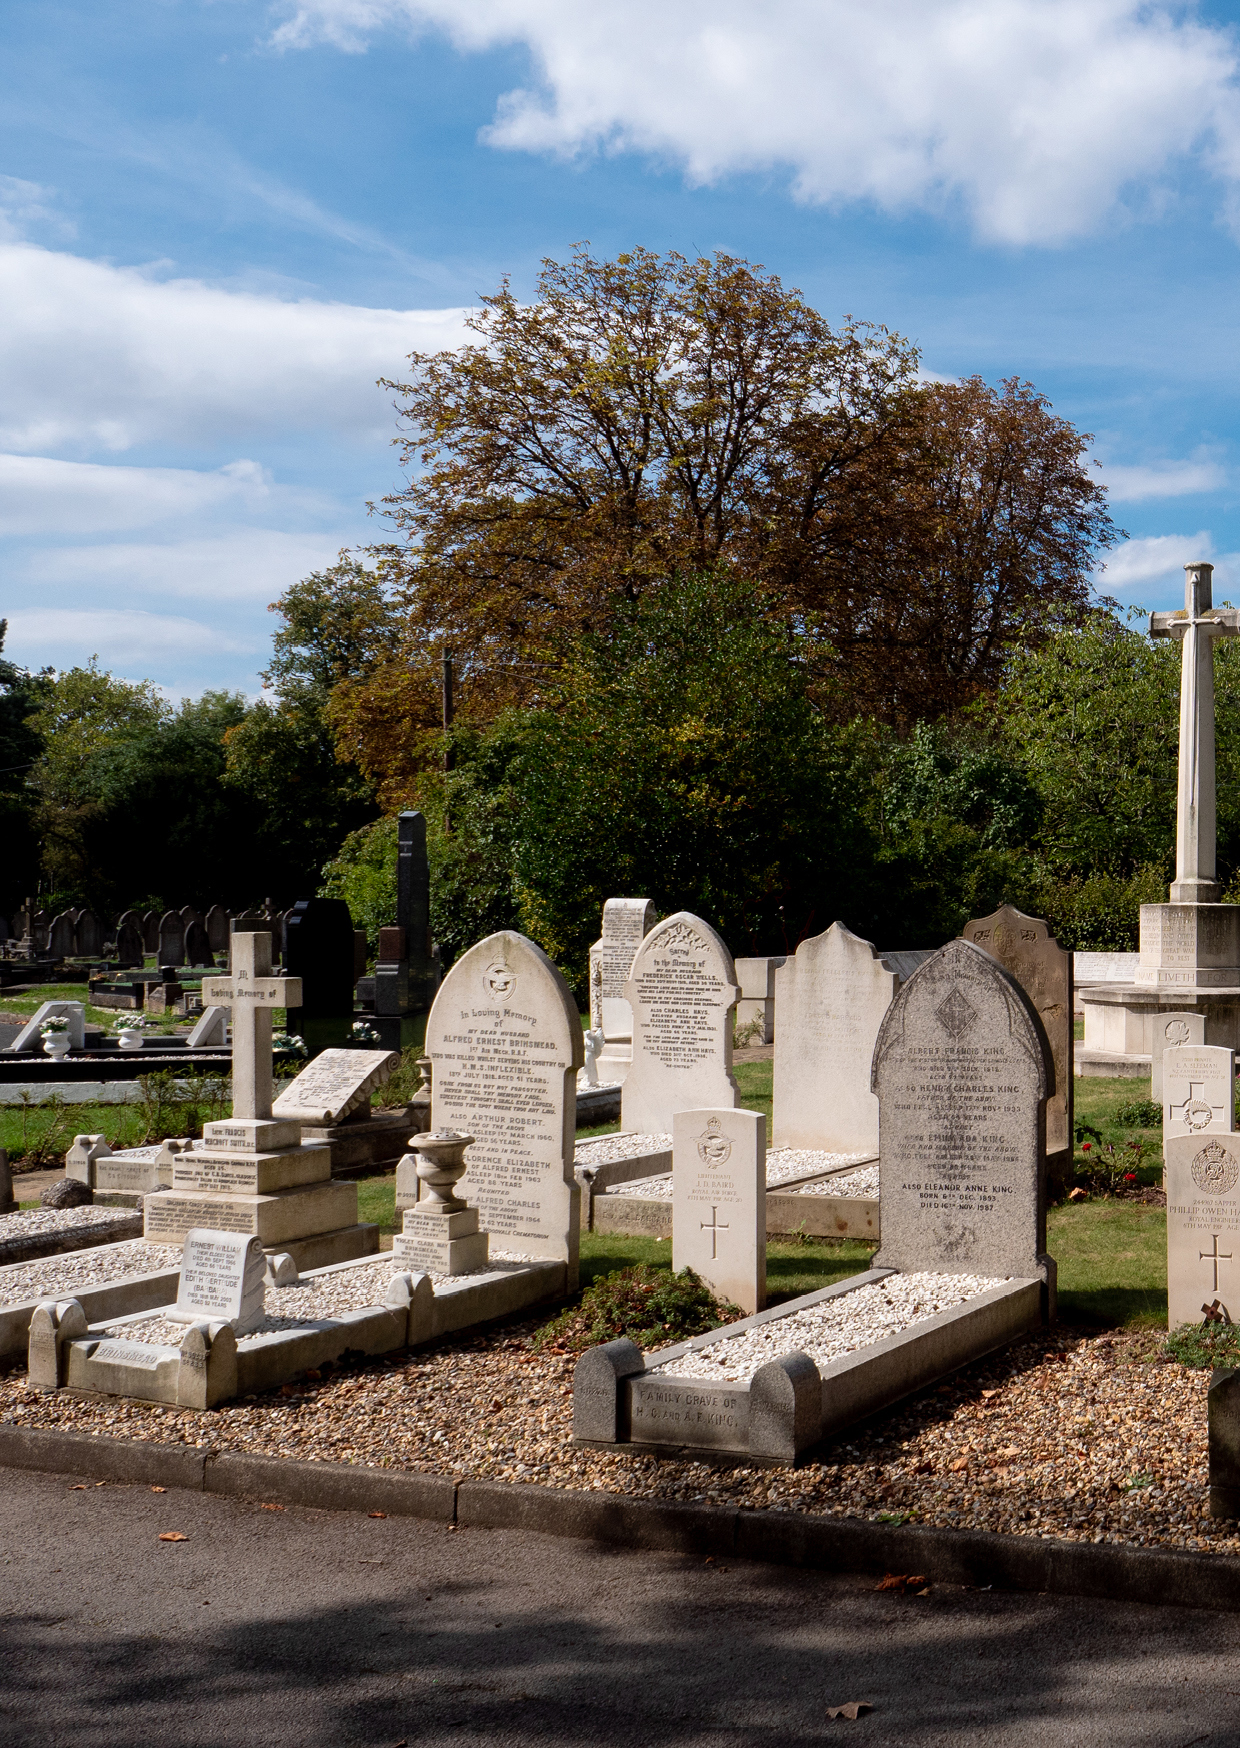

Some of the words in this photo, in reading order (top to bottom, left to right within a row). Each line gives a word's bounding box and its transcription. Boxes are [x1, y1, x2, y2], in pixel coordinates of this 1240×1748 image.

[1159, 973, 1195, 982] LIVETH
[1207, 973, 1227, 981] FOR
[444, 1035, 473, 1044] ALFRED
[477, 1037, 506, 1046] ERNEST
[472, 1114, 506, 1123] ARTHUR
[510, 1132, 535, 1140] MARCH
[463, 1154, 502, 1164] FLORENCE
[506, 1159, 551, 1169] ELIZABETH
[512, 1167, 539, 1175] ERNEST
[925, 1184, 960, 1192] ELEANOR
[476, 1196, 504, 1204] ALFRED
[507, 1199, 541, 1209] CHARLES
[1202, 1207, 1227, 1215] OWEN
[488, 1212, 524, 1222] SEPTEMBER
[191, 1241, 215, 1250] ERNEST
